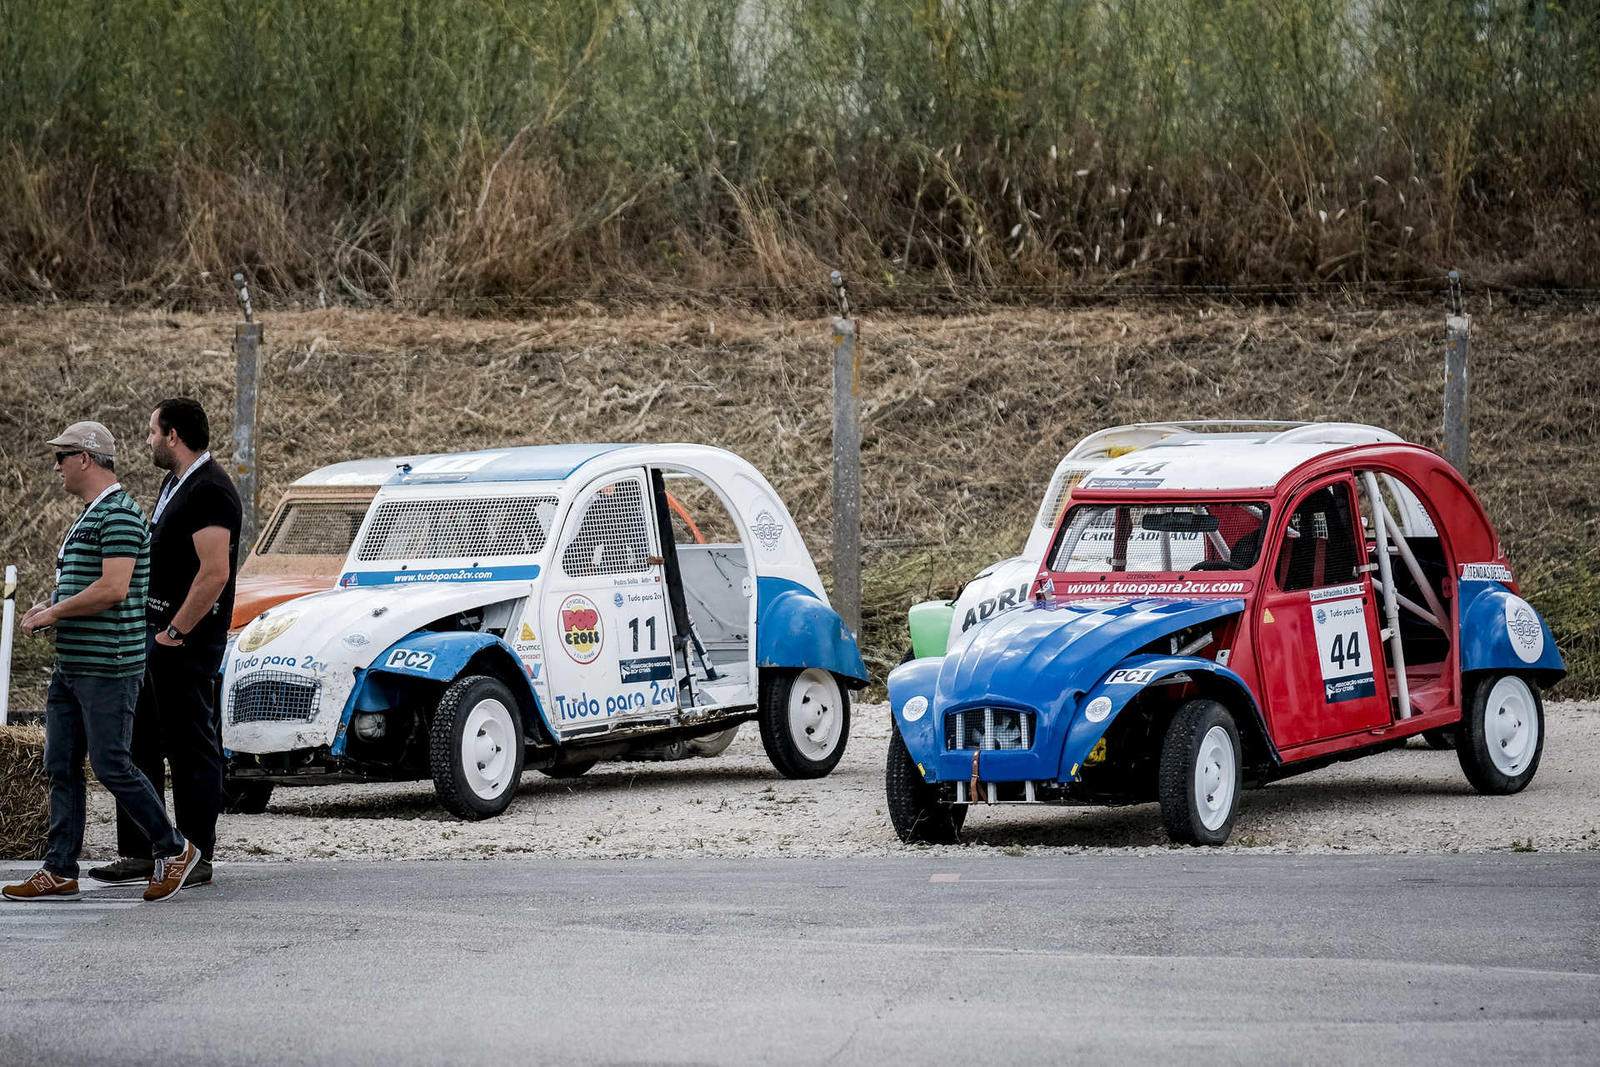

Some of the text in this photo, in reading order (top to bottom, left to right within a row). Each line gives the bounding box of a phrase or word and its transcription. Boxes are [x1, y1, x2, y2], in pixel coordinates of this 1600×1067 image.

[1116, 461, 1171, 475] 44
[393, 570, 492, 583] www.tudopara2cv.com
[628, 594, 641, 602] Tudo
[641, 594, 653, 603] para
[562, 609, 598, 632] POP
[1330, 609, 1342, 617] Tudo
[1343, 608, 1354, 617] para
[565, 631, 600, 645] CROSS
[629, 616, 655, 652] 11
[1331, 631, 1361, 670] 44
[234, 655, 259, 673] Tudo
[260, 656, 296, 669] para
[390, 651, 432, 669] PC2
[1109, 670, 1153, 682] PC1
[556, 692, 600, 720] Tudo
[606, 692, 645, 716] para
[650, 680, 675, 705] 2cv
